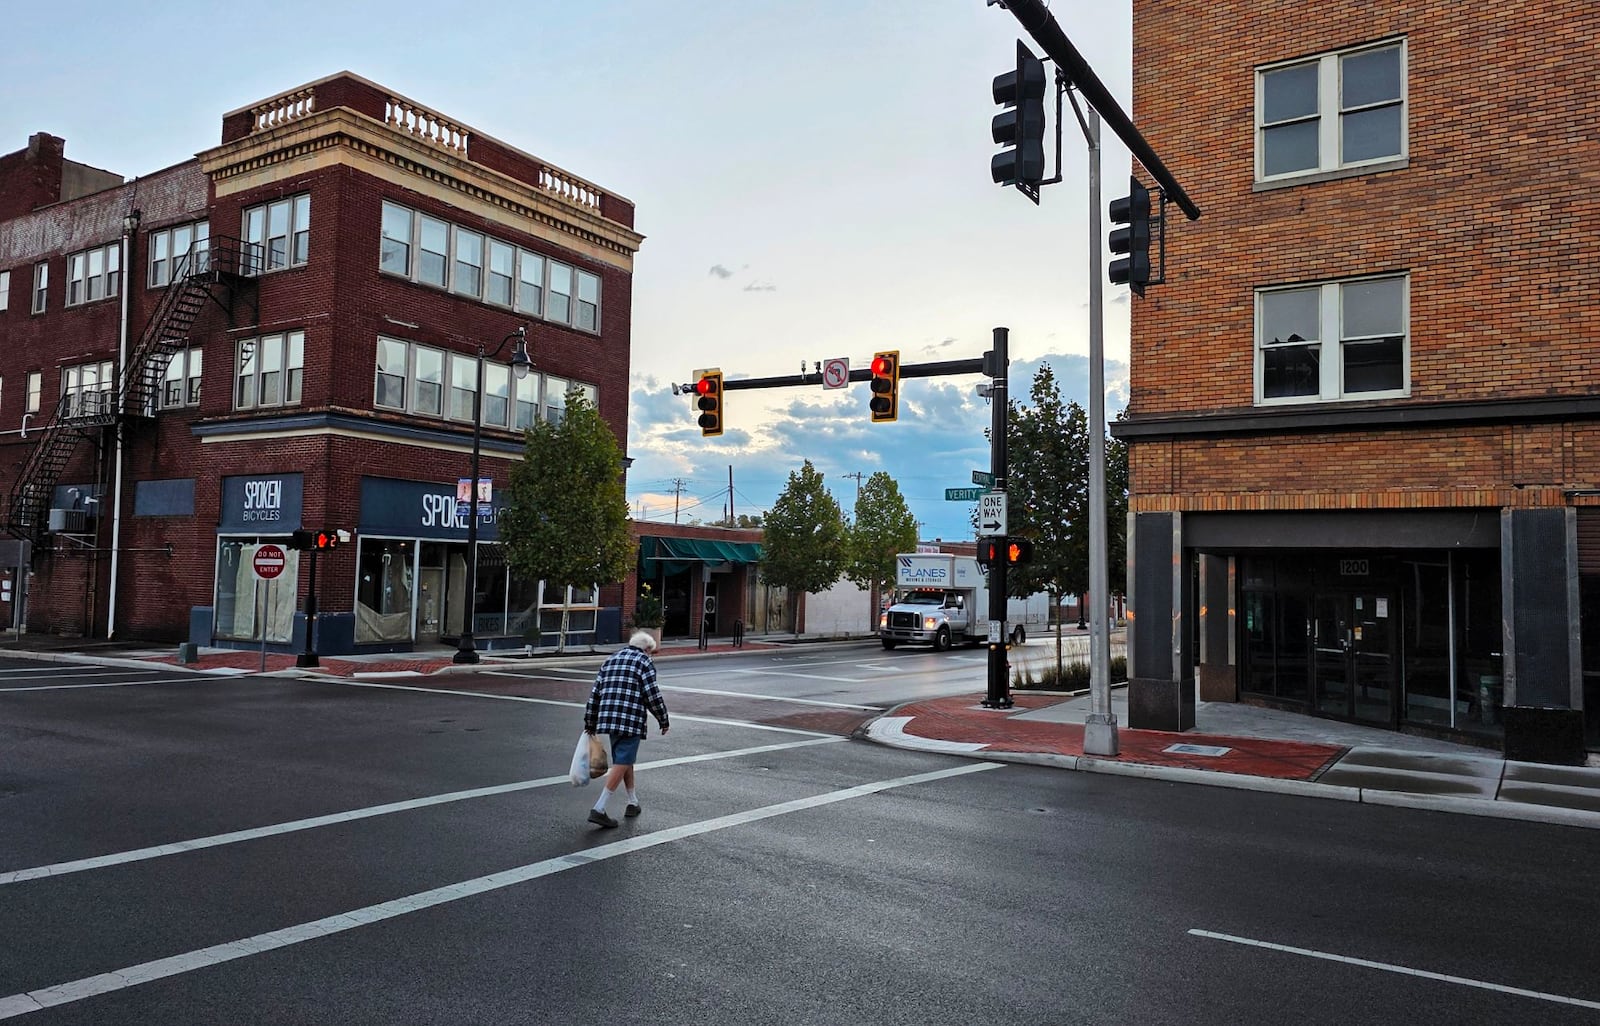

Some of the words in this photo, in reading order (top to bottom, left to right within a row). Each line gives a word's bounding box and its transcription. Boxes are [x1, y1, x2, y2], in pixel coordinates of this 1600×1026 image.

[244, 480, 281, 508] SPOKEN
[948, 489, 977, 499] VERITY
[984, 497, 1002, 507] ONE
[243, 510, 280, 521] BICYCLES
[983, 509, 1003, 518] WAY
[330, 534, 337, 547] 2
[901, 568, 946, 577] PLANES
[1342, 561, 1367, 574] 1200
